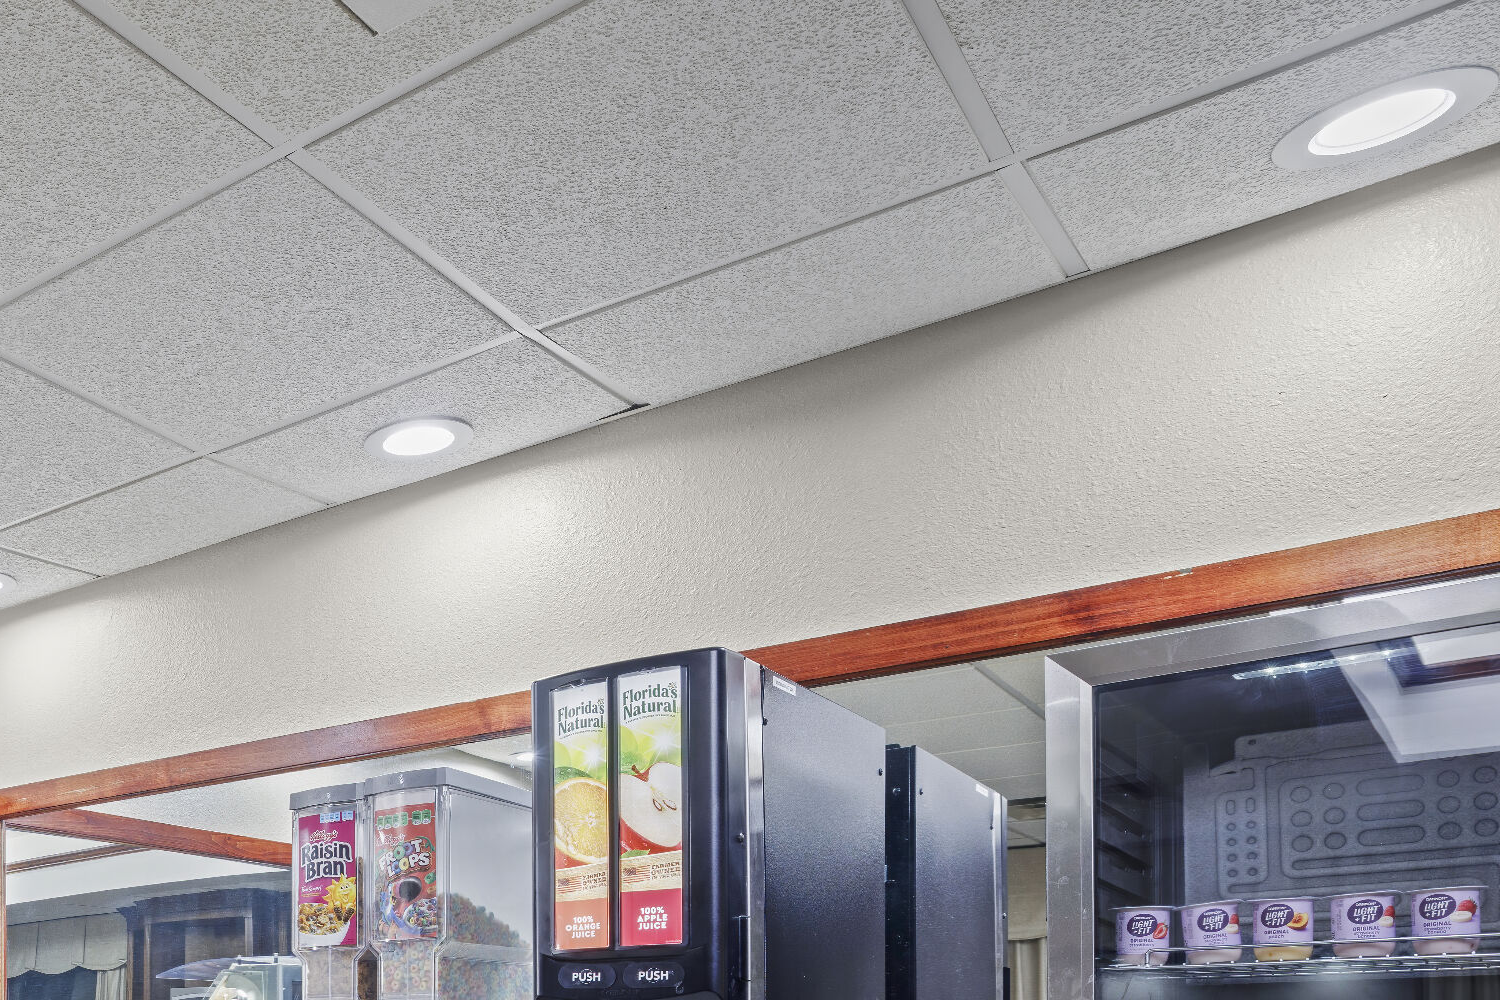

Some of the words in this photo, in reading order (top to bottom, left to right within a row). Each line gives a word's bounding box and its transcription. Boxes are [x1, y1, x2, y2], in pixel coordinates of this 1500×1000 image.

[622, 683, 678, 706] Florida's
[557, 700, 605, 722] Florida's
[622, 700, 677, 720] Natural
[558, 715, 604, 736] Natural
[301, 842, 352, 865] Raisin
[305, 859, 346, 881] Bran
[640, 906, 665, 915] 100%
[572, 915, 594, 924] 100%
[637, 913, 668, 923] APPLE
[565, 922, 601, 932] ORANGE
[638, 921, 667, 931] JUICE
[571, 930, 596, 939] JUICE
[572, 972, 601, 982] PUSH
[638, 970, 669, 981] PUSH
